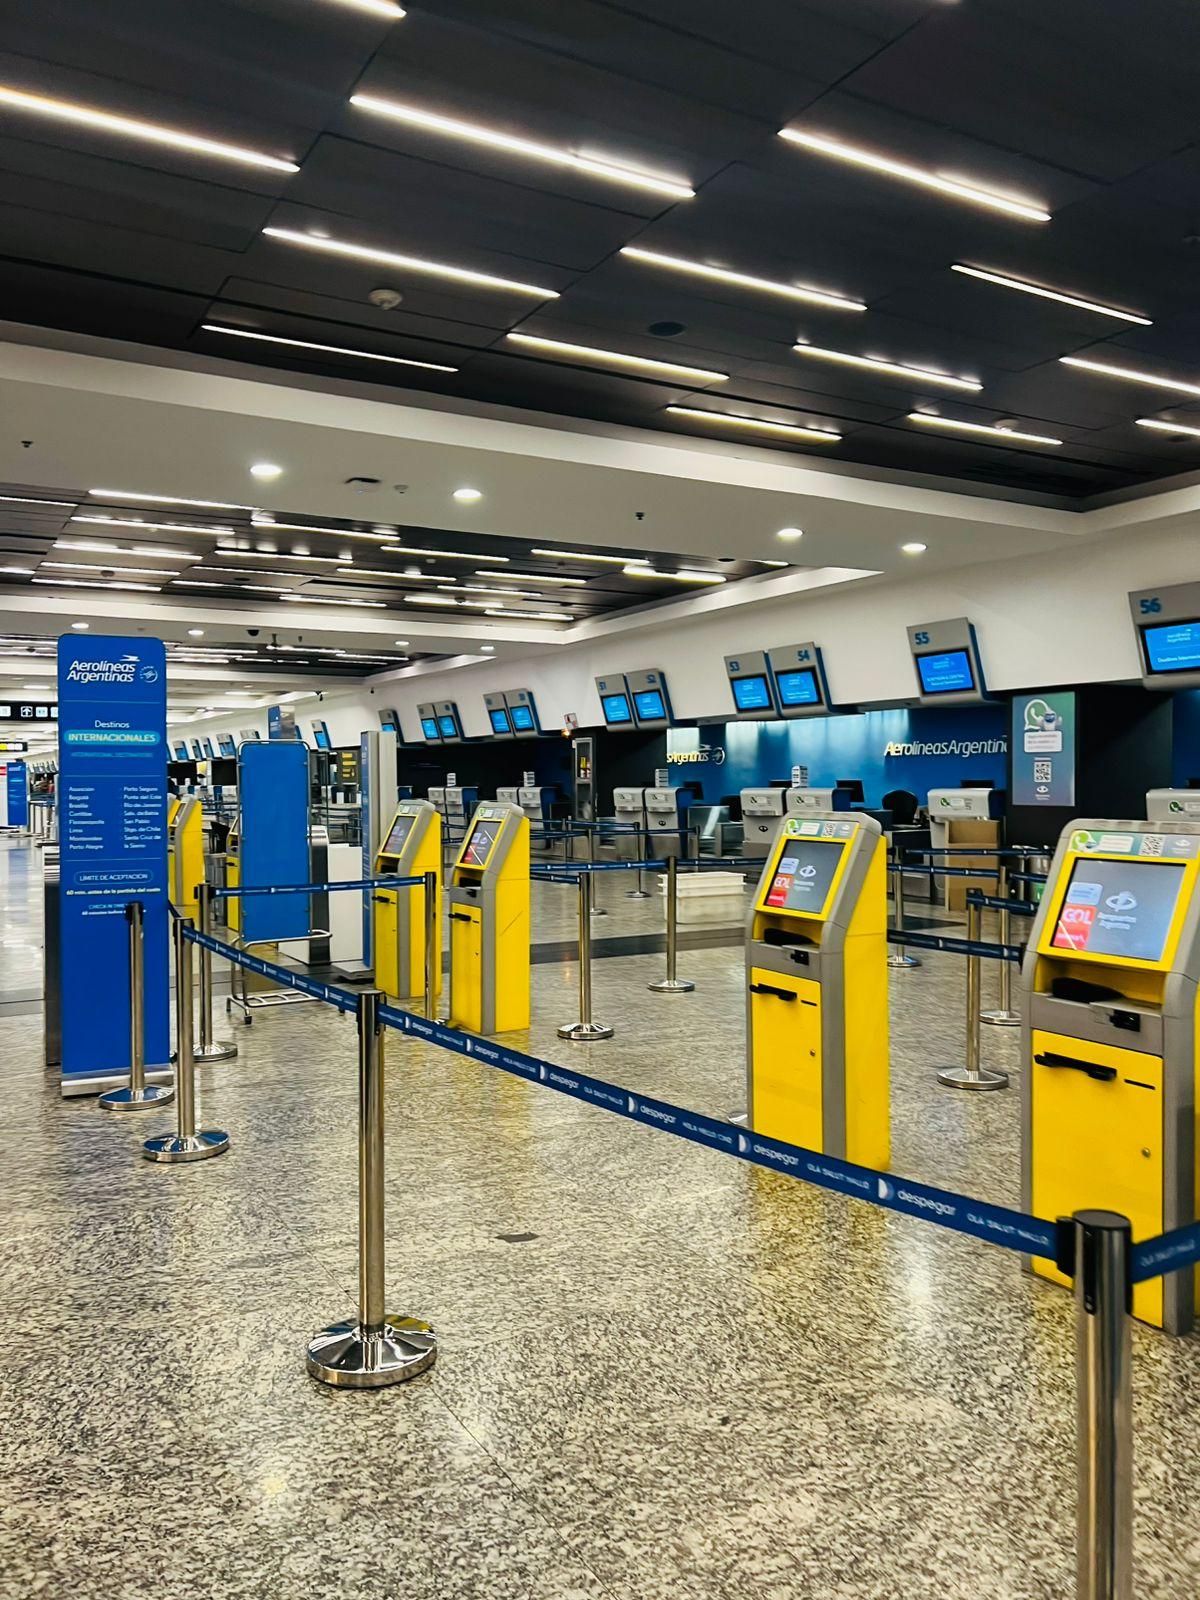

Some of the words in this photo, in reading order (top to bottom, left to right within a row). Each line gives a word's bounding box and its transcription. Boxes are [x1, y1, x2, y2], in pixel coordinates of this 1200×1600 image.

[1140, 598, 1162, 614] 56
[915, 631, 930, 645] 55
[798, 649, 810, 661] 54
[729, 661, 740, 672] 53
[66, 670, 135, 684] Argentinas
[646, 673, 657, 684] 52
[94, 719, 130, 729] Destinos
[67, 733, 157, 743] INTERNACIONALES
[550, 1073, 580, 1089] despegar
[640, 1105, 677, 1124] despegar
[753, 1144, 799, 1167] despegar
[897, 1189, 957, 1217] despegar
